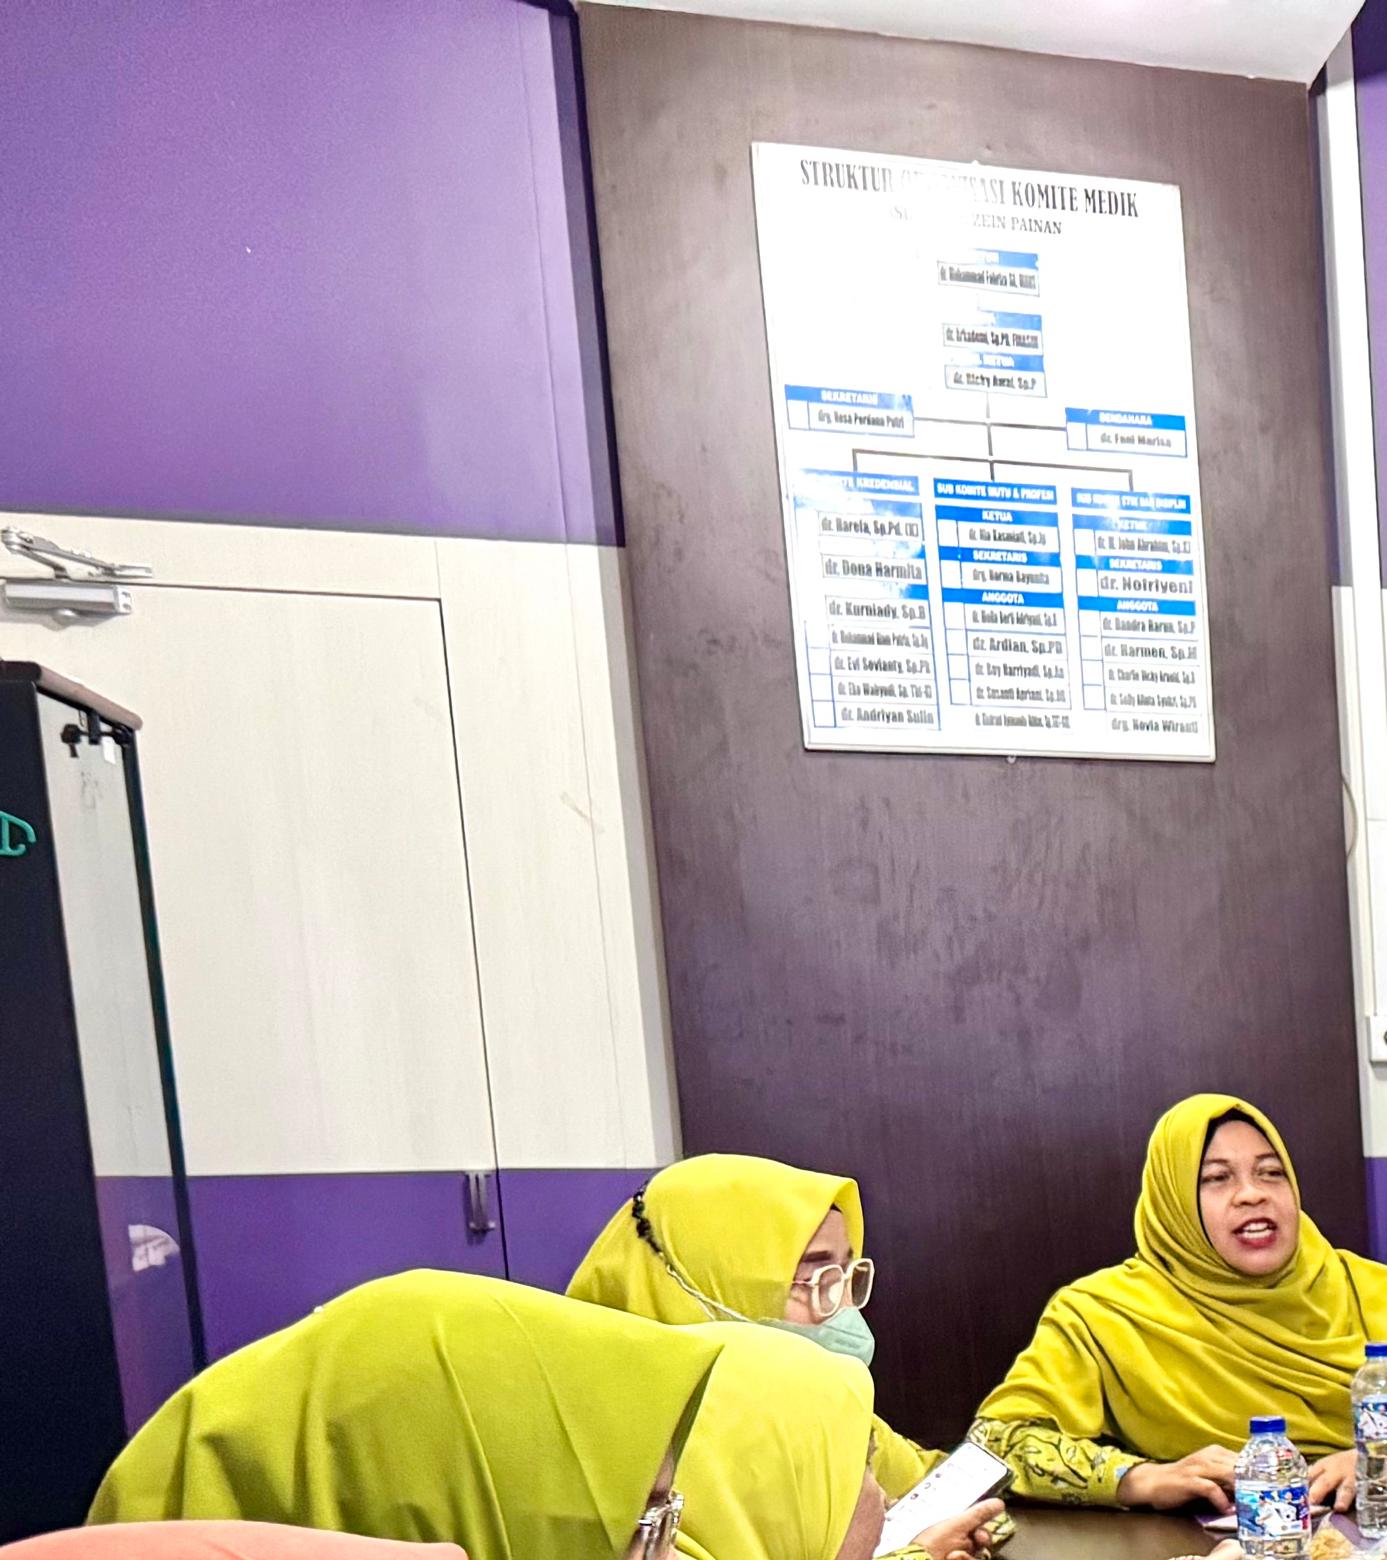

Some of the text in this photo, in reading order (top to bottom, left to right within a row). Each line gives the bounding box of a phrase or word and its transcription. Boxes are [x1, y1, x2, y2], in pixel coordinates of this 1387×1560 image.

[800, 159, 893, 193] STRUKTUR
[1011, 180, 1078, 212] KOMITE
[1084, 188, 1139, 217] MEDIK
[1011, 216, 1062, 235] PAINAN
[982, 509, 1013, 522] KETUA
[973, 550, 1028, 564] SEKRETARIS
[1100, 575, 1119, 591] dr.
[982, 591, 1025, 605] ANGGOTA
[1117, 599, 1159, 612] ANGGOTA
